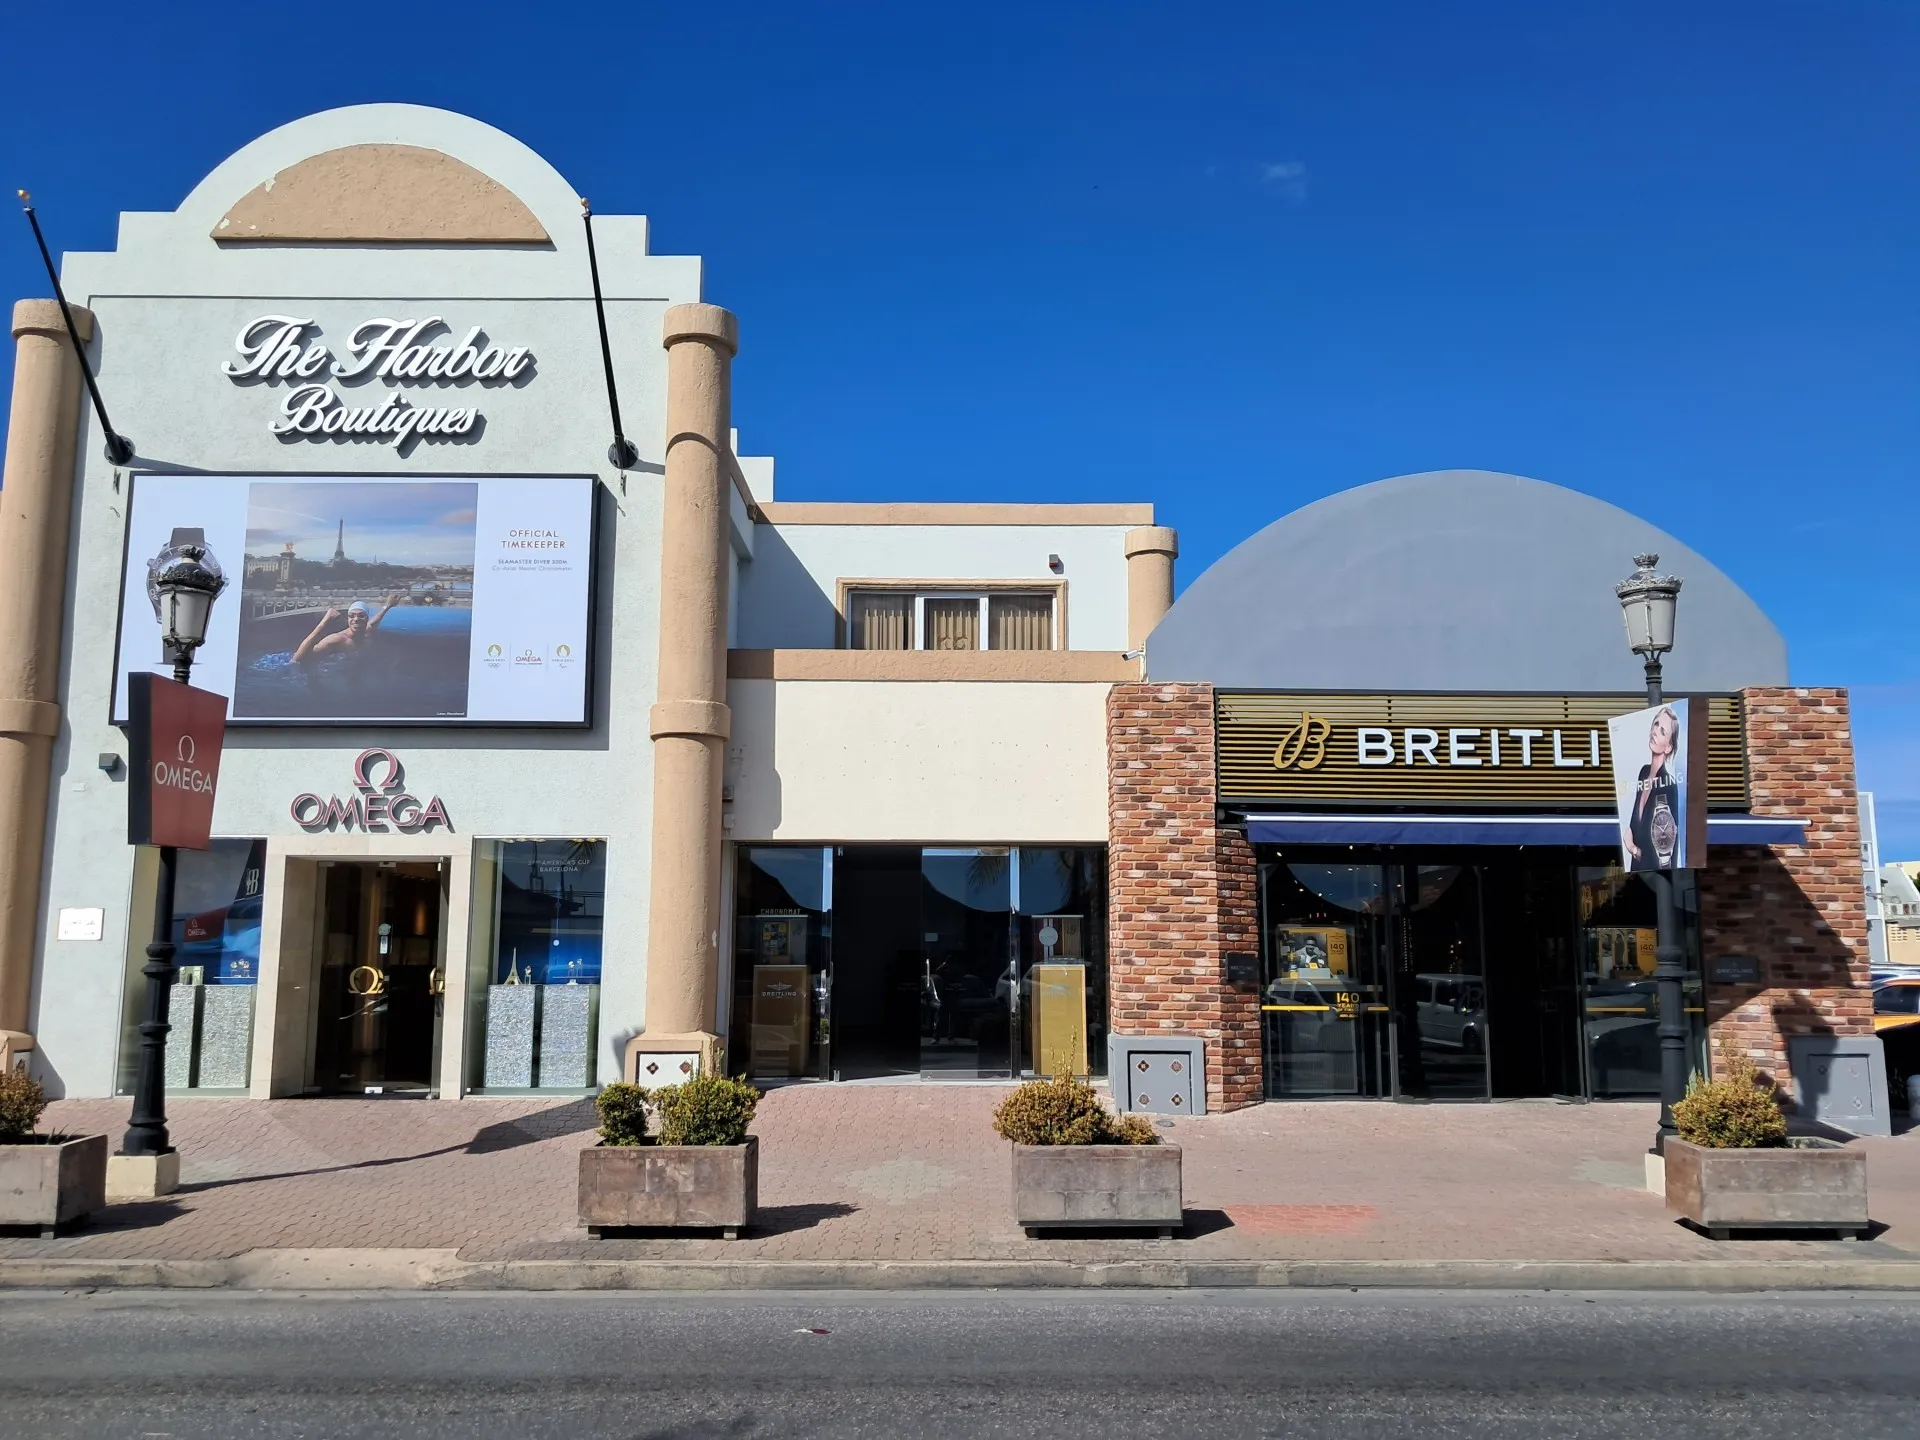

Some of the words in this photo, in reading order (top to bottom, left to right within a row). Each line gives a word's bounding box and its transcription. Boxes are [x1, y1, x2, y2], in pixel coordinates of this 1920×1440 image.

[220, 314, 330, 378] The
[330, 315, 531, 379] Harbor
[268, 383, 480, 449] Boutiques
[501, 540, 566, 549] TIMEKEEPER
[509, 529, 559, 538] OFFICIAL
[1357, 728, 1600, 767] BREITLI
[154, 761, 214, 795] OMEGA
[1630, 772, 1685, 792] BREITLING
[290, 793, 448, 827] OMEGA
[1336, 992, 1360, 1004] 140
